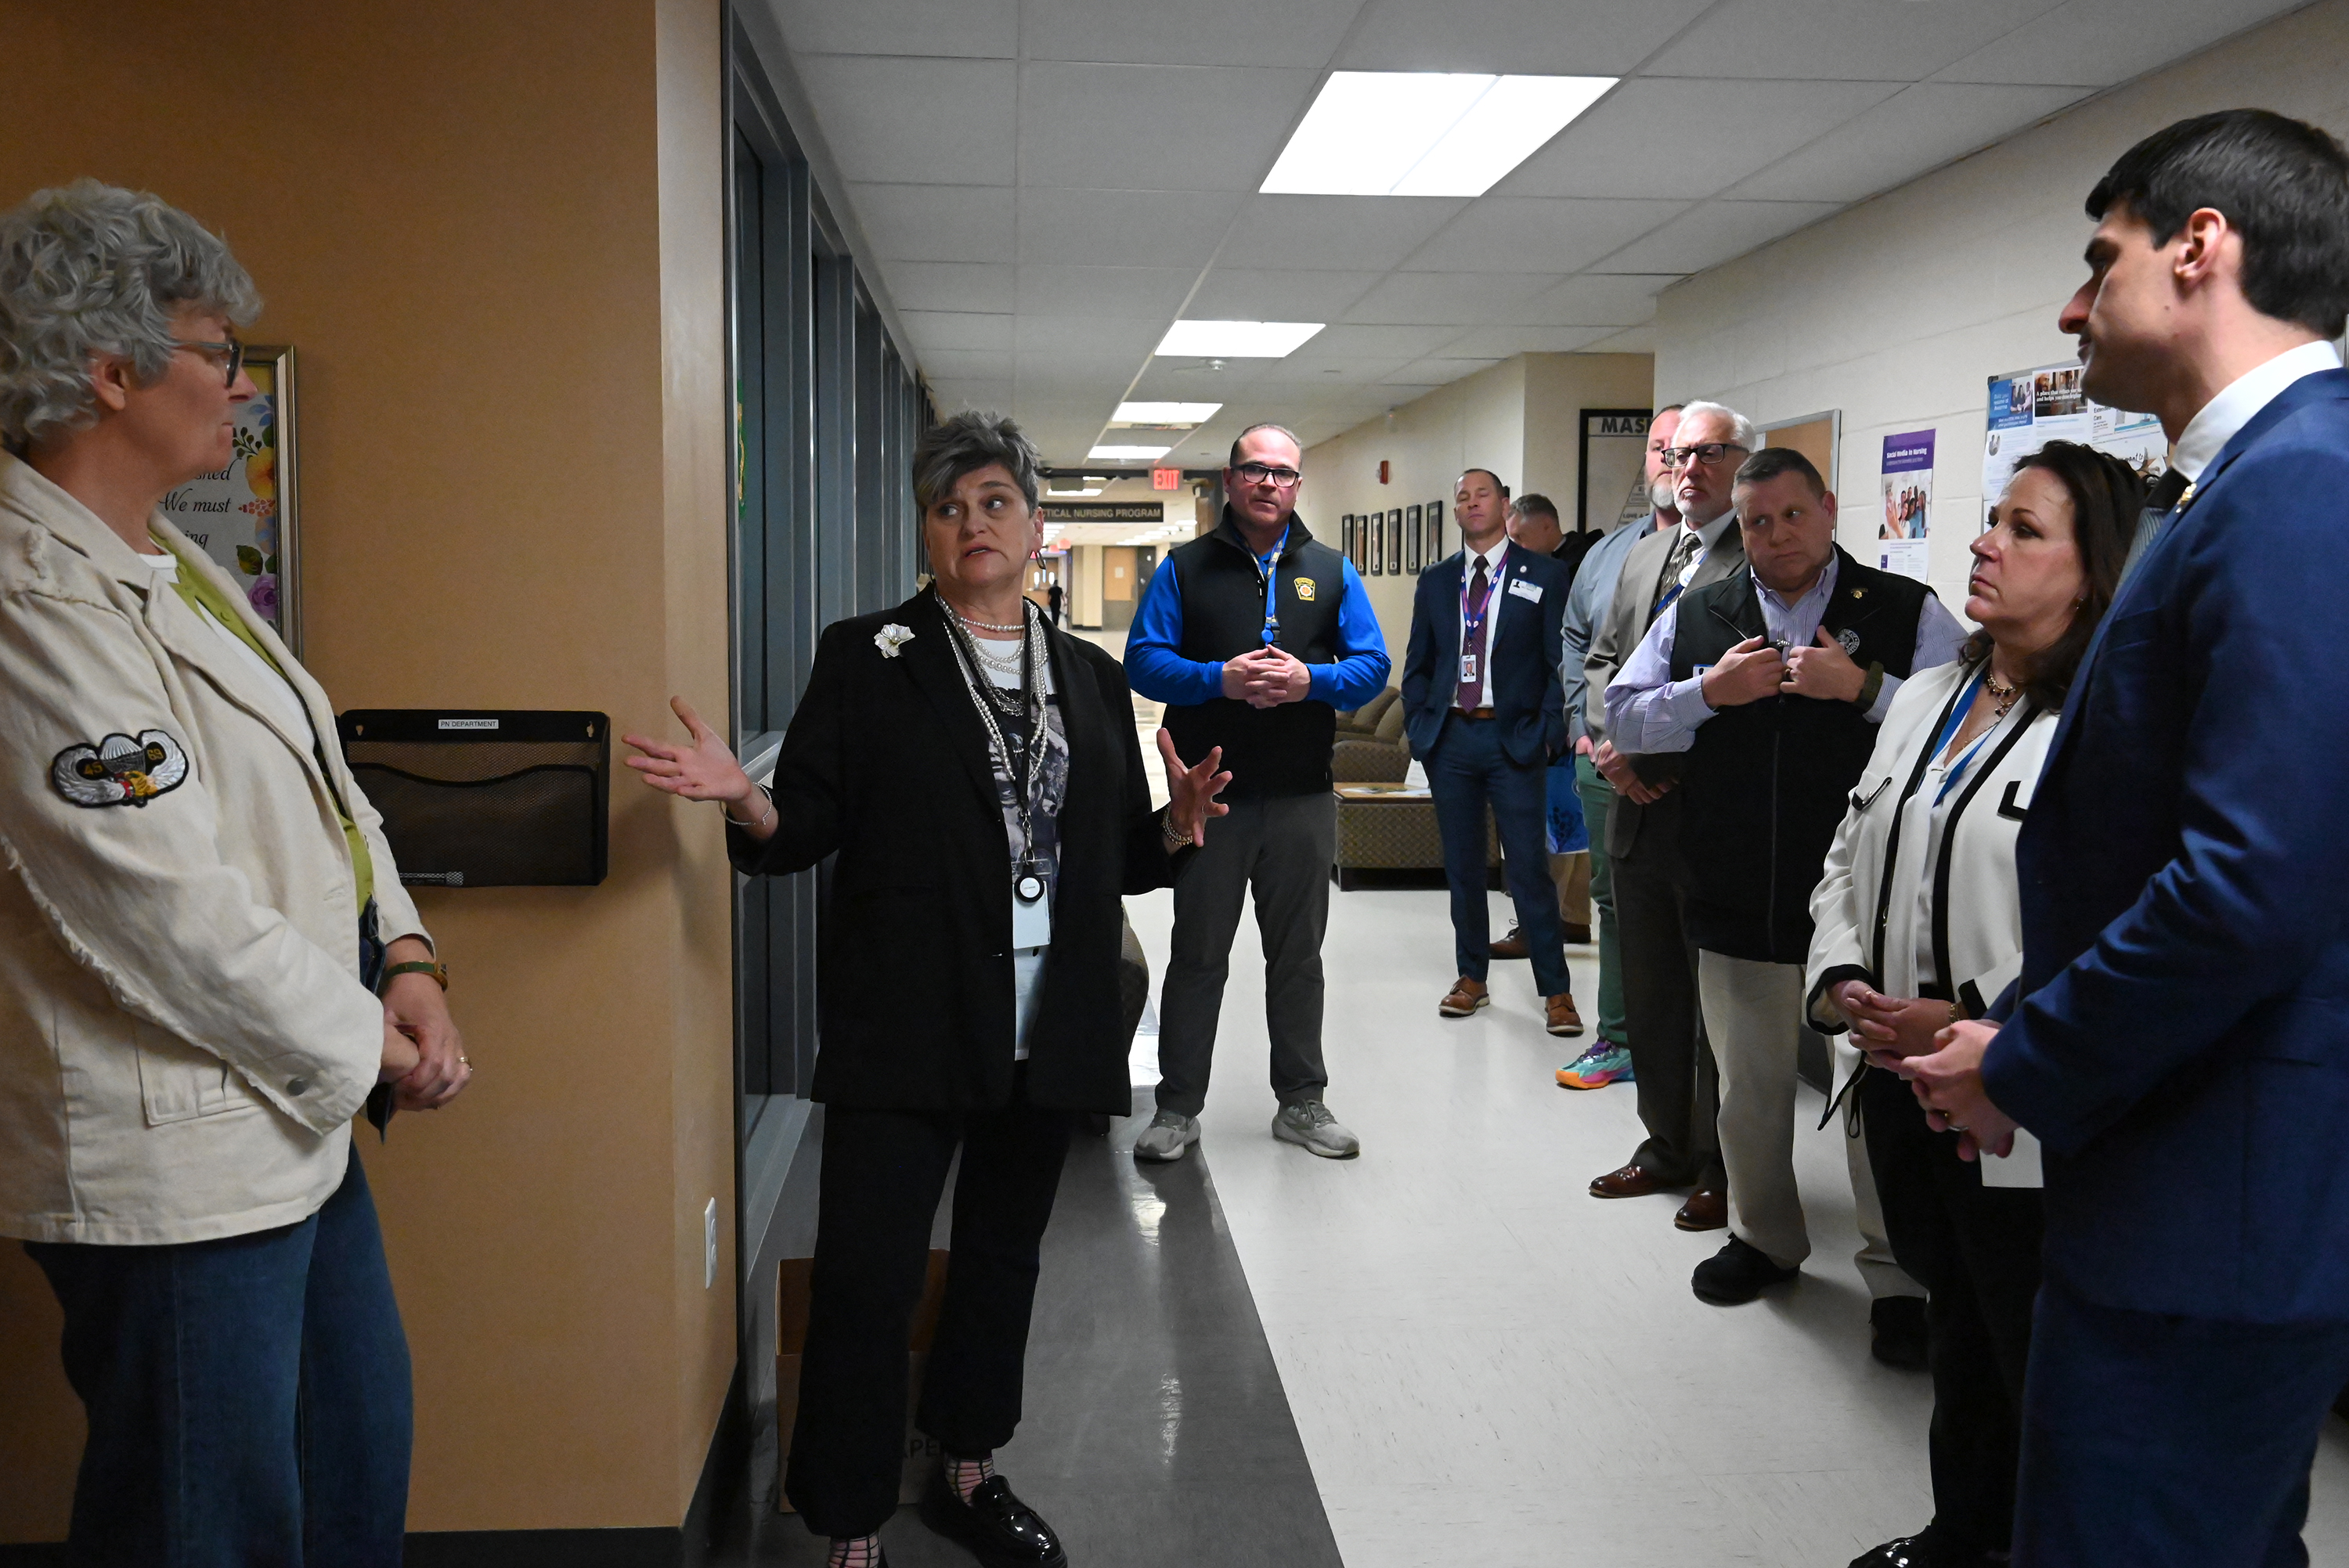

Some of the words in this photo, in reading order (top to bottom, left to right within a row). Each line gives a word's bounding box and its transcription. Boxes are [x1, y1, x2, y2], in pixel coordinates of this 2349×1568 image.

[1153, 469, 1180, 490] EXIT
[158, 488, 193, 511] We
[193, 497, 232, 513] must
[1073, 508, 1113, 518] NURSING
[1115, 508, 1161, 518] PROGRAM
